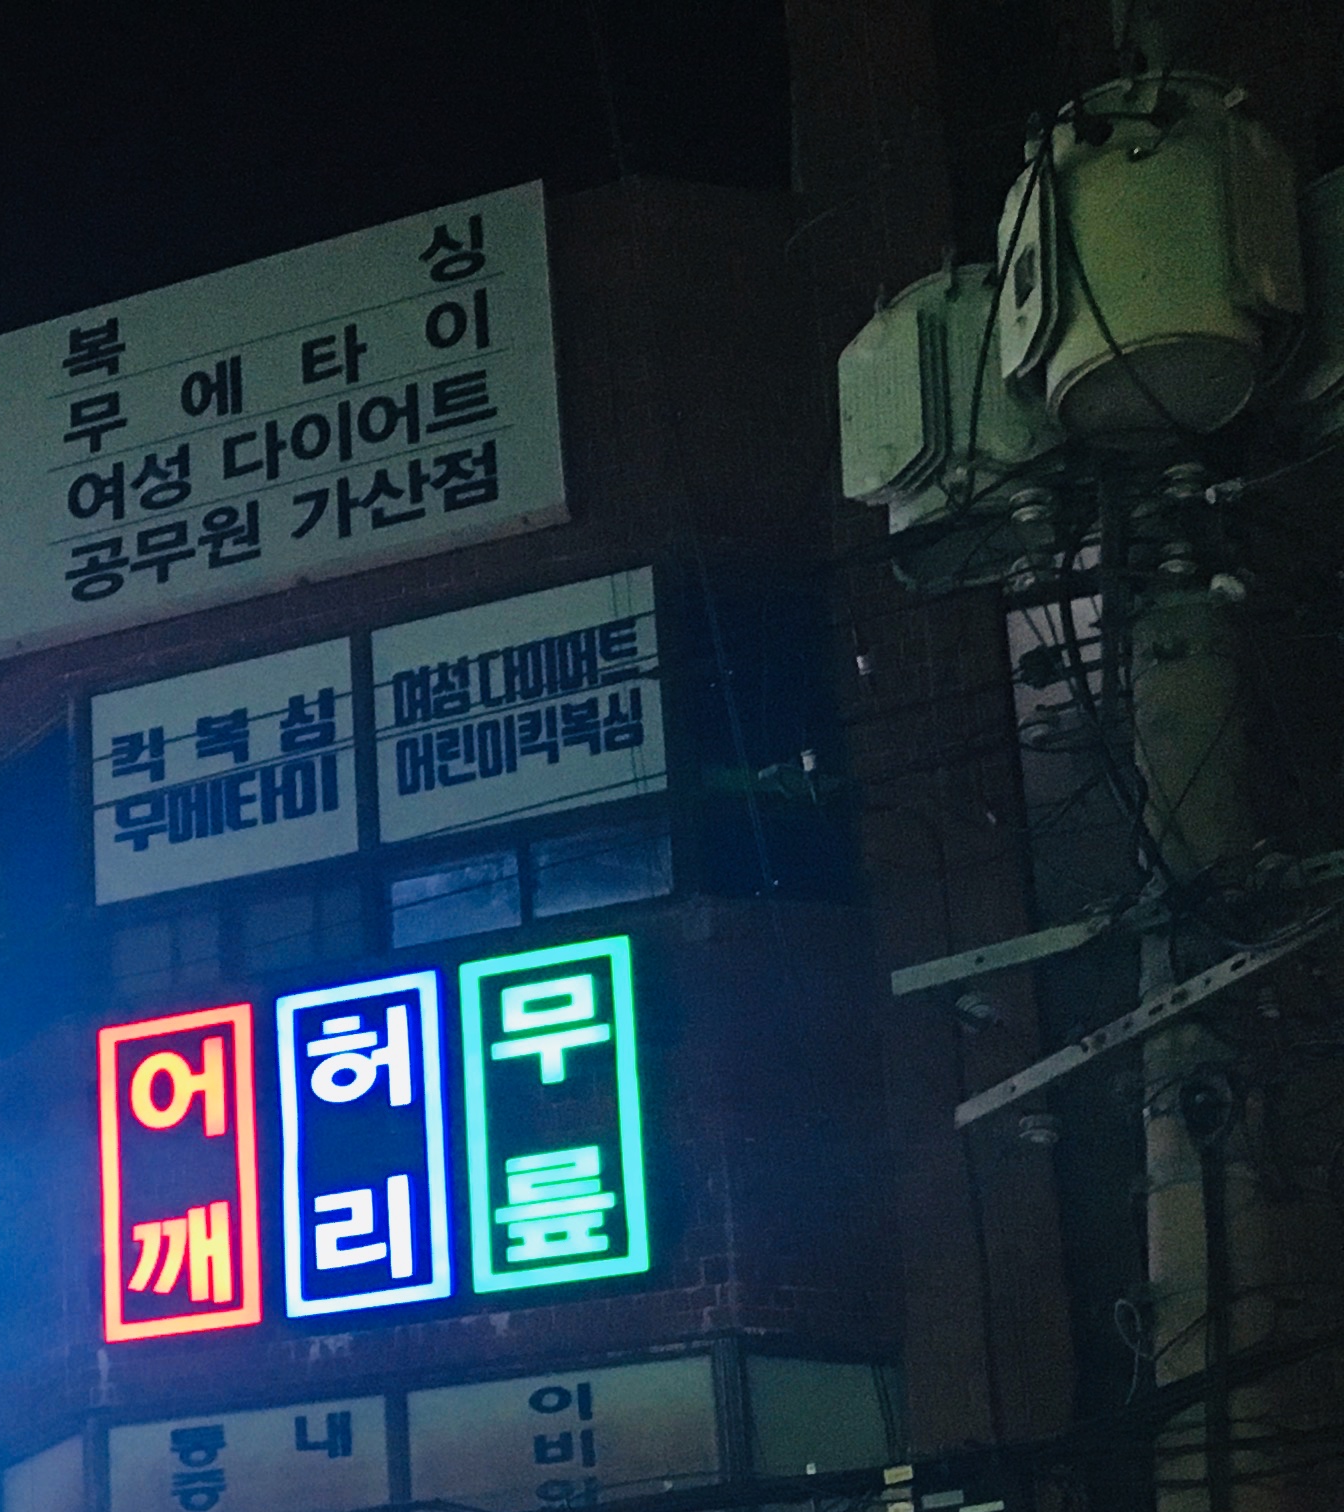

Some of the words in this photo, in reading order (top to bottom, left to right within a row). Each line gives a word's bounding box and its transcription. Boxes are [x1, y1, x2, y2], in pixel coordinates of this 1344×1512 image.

[62, 288, 490, 454] 무에타이
[68, 445, 191, 521] 여성
[223, 369, 497, 480] 다이어트
[65, 501, 261, 602] 공무원
[292, 440, 498, 539] 가산점
[113, 745, 339, 852] 무에타이
[127, 1035, 233, 1304] 어깨
[306, 1003, 413, 1280] 허리
[490, 973, 615, 1263] 무릎
